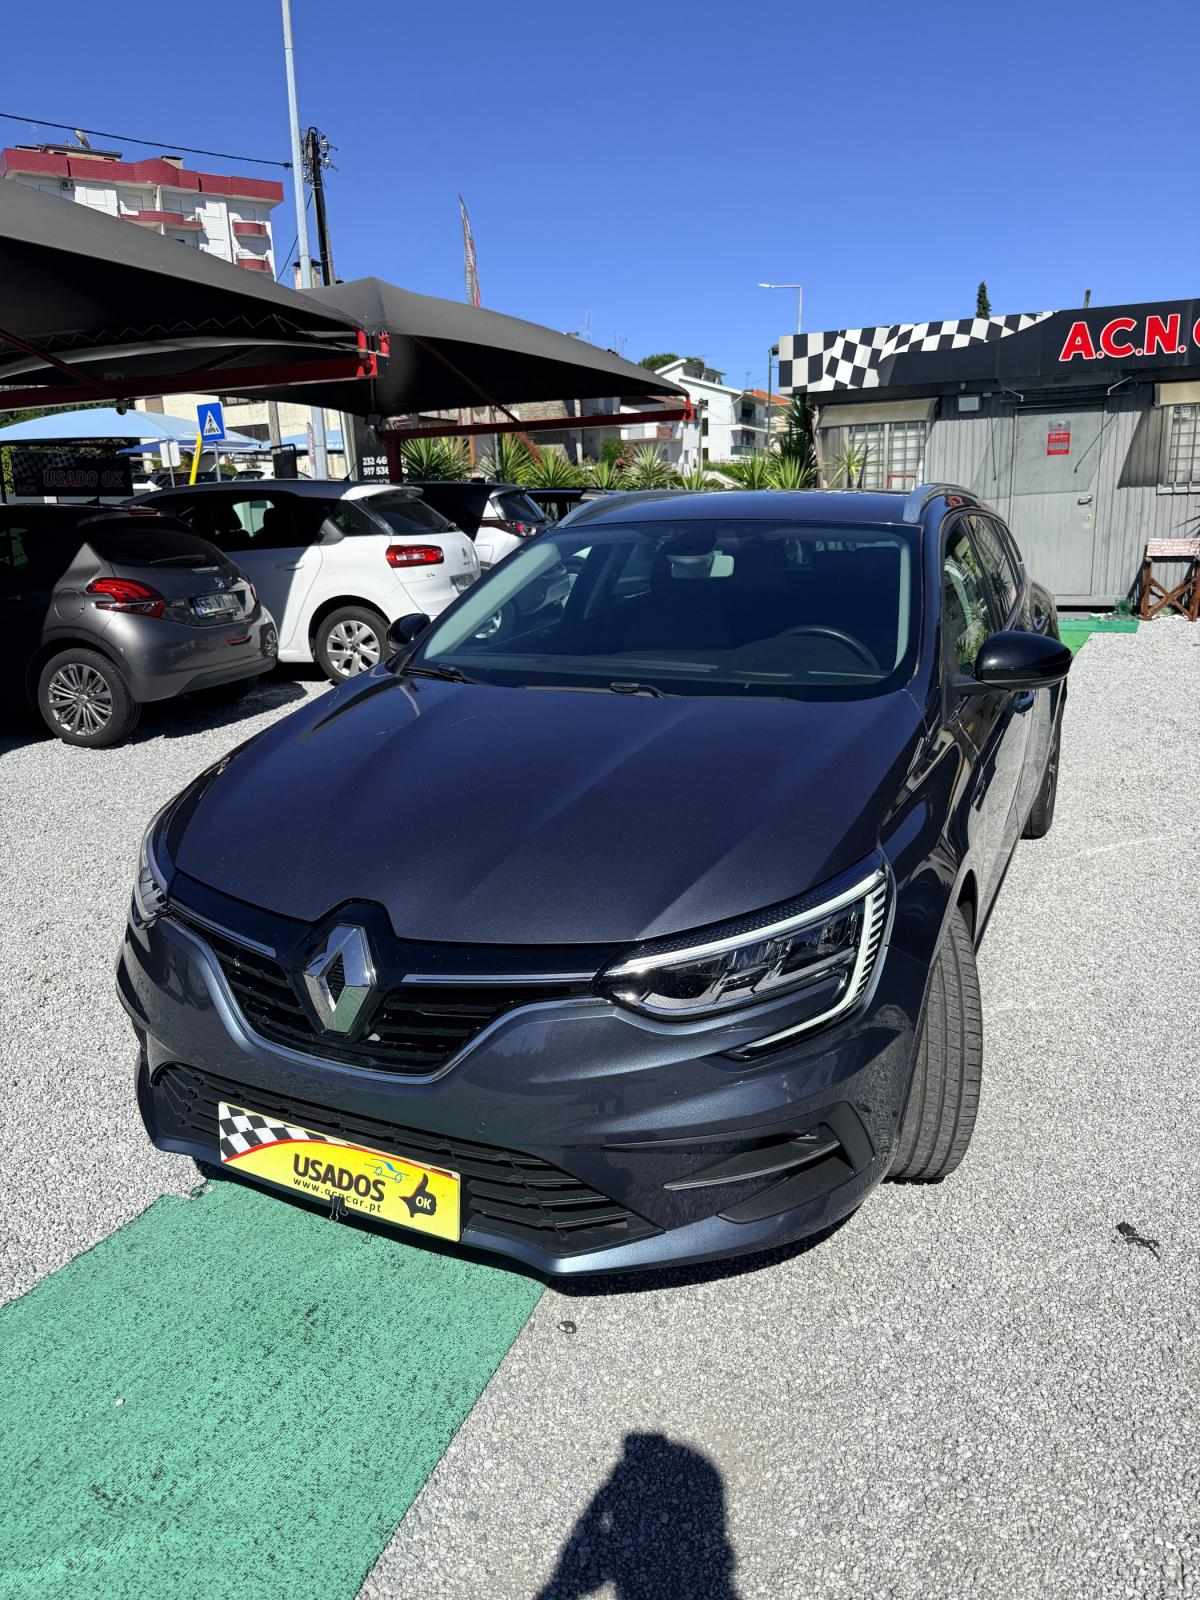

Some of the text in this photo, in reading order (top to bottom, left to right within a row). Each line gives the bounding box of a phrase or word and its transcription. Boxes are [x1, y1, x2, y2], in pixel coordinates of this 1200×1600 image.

[376, 456, 388, 465] 46
[293, 1153, 386, 1202] USADOS
[415, 1196, 432, 1210] OK
